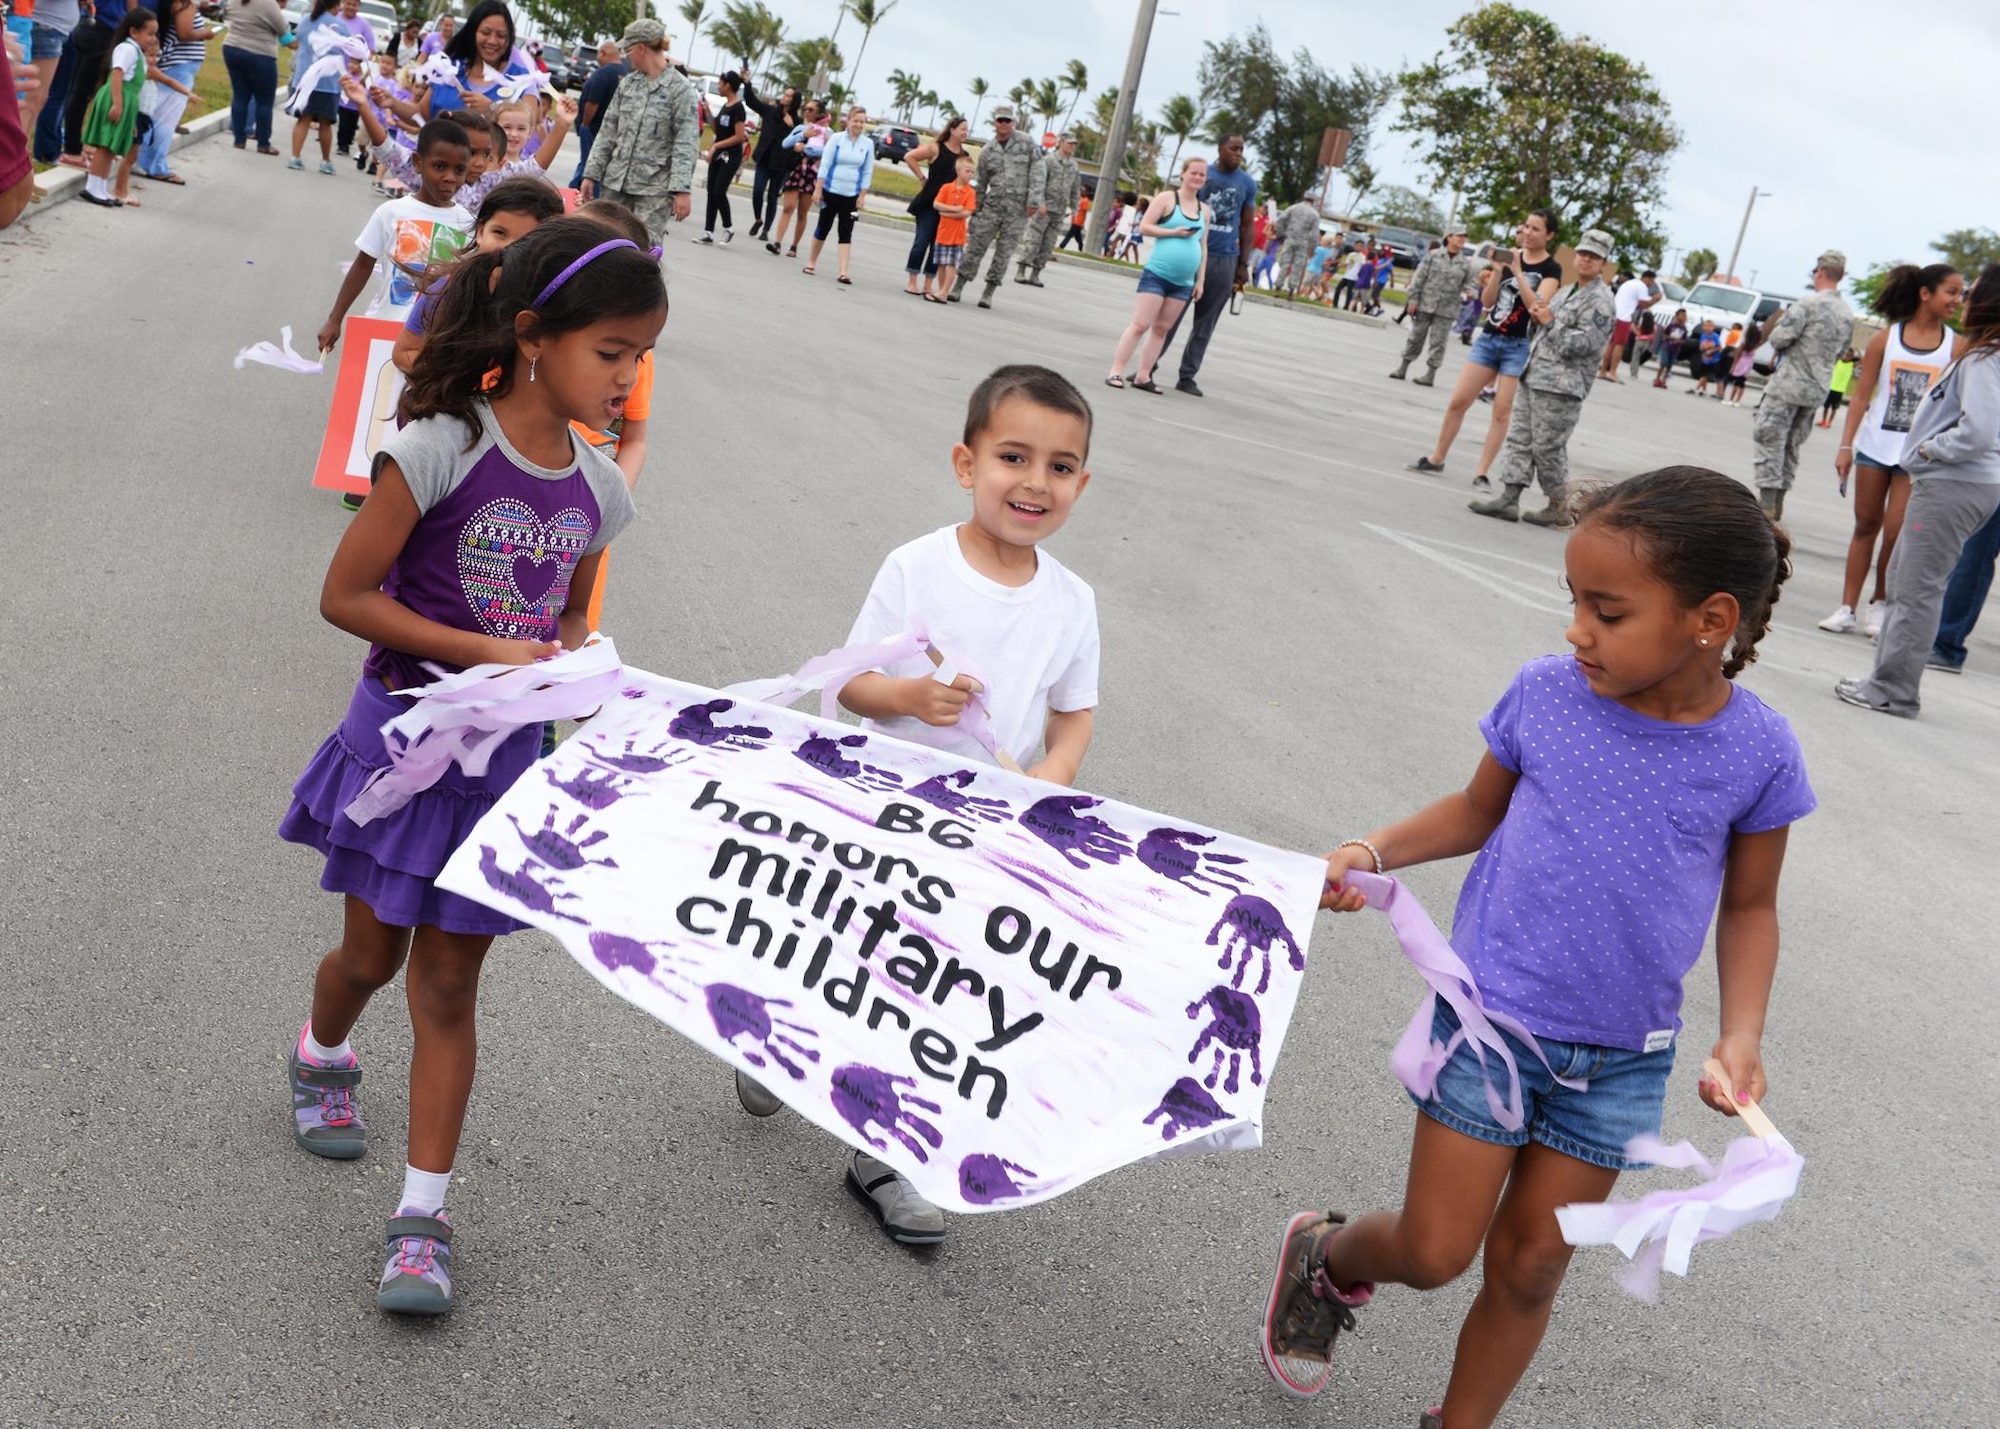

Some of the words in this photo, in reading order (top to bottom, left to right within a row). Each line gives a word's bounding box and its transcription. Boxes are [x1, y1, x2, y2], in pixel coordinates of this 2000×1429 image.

[691, 780, 956, 914] honors
[708, 838, 1044, 1052] military
[676, 896, 1008, 1119] children
